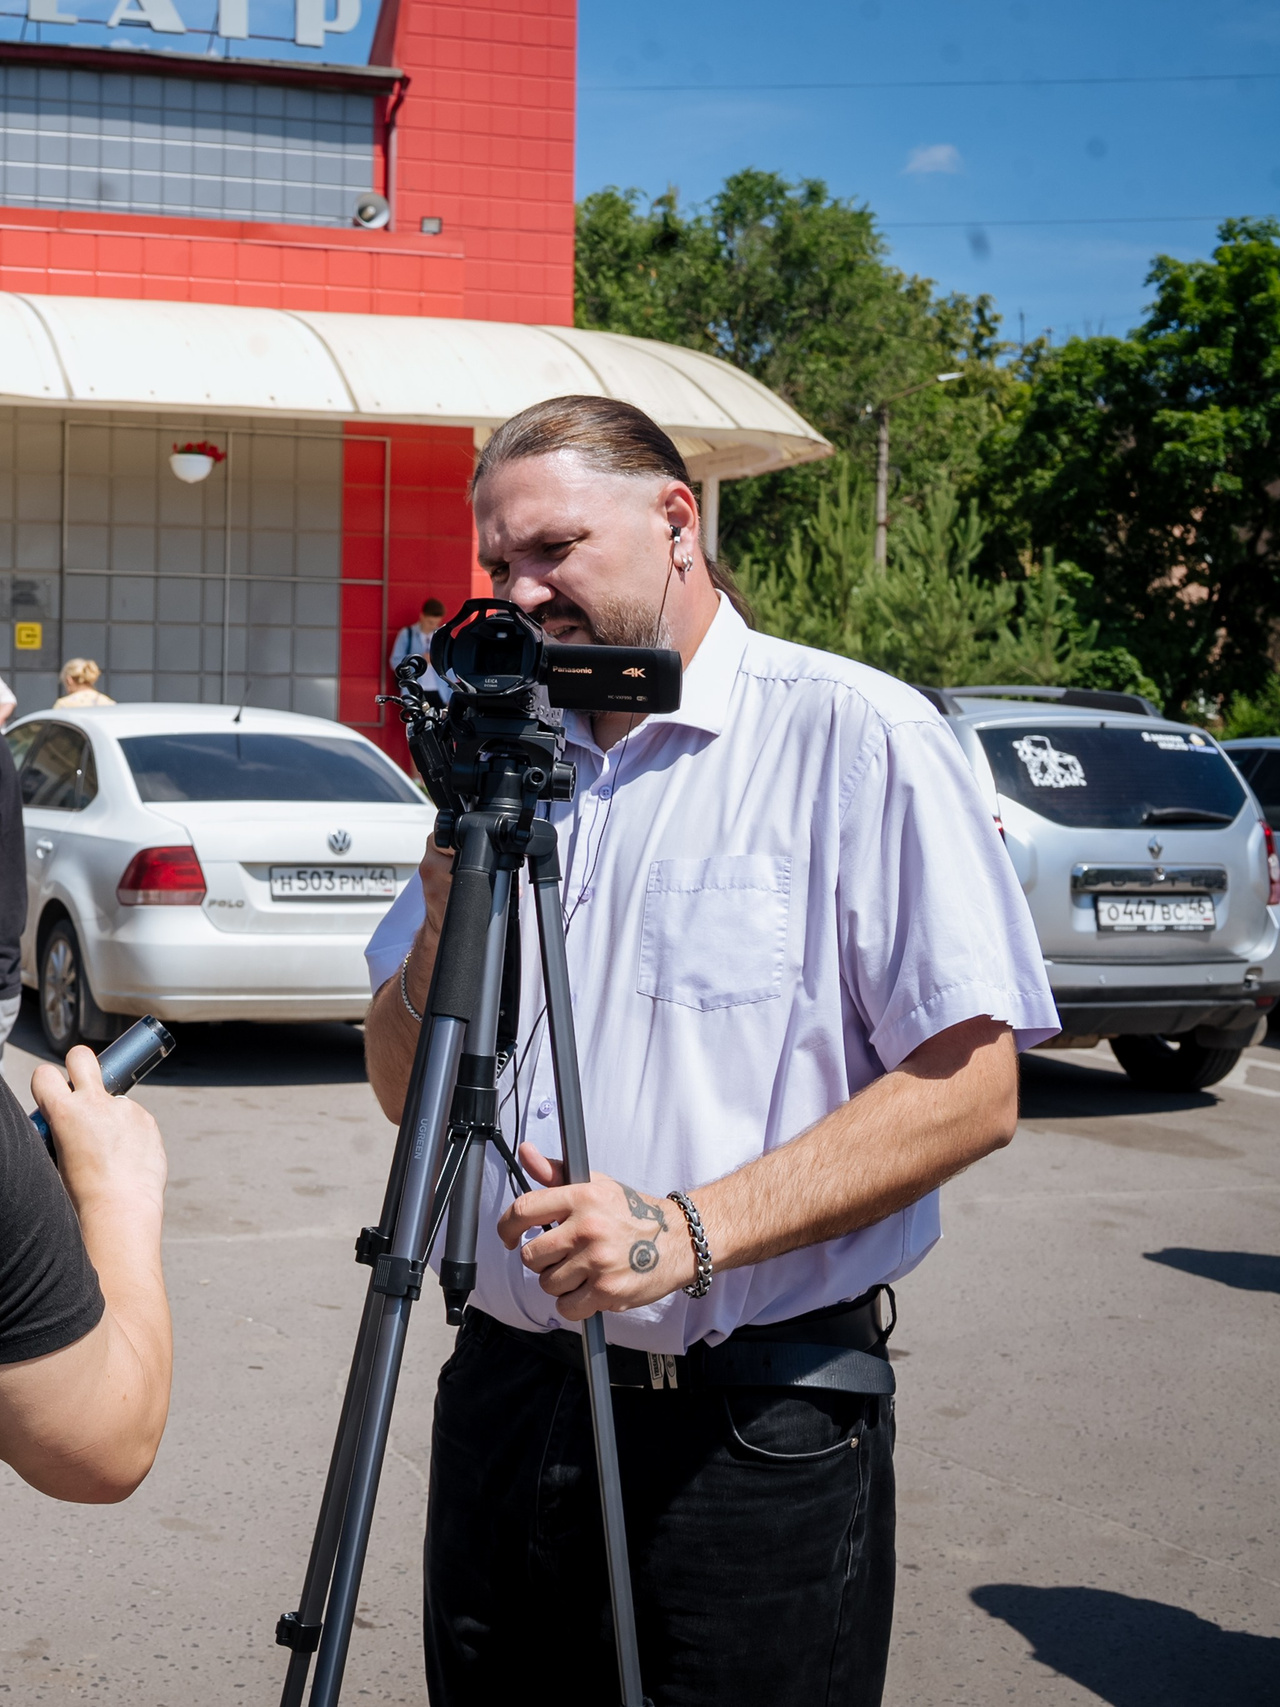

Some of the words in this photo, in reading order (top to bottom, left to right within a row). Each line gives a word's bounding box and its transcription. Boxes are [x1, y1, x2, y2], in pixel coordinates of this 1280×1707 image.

[552, 665, 593, 674] Panasonic
[622, 667, 646, 678] 4K
[208, 899, 245, 908] POLO
[414, 1118, 429, 1160] UGREEN
